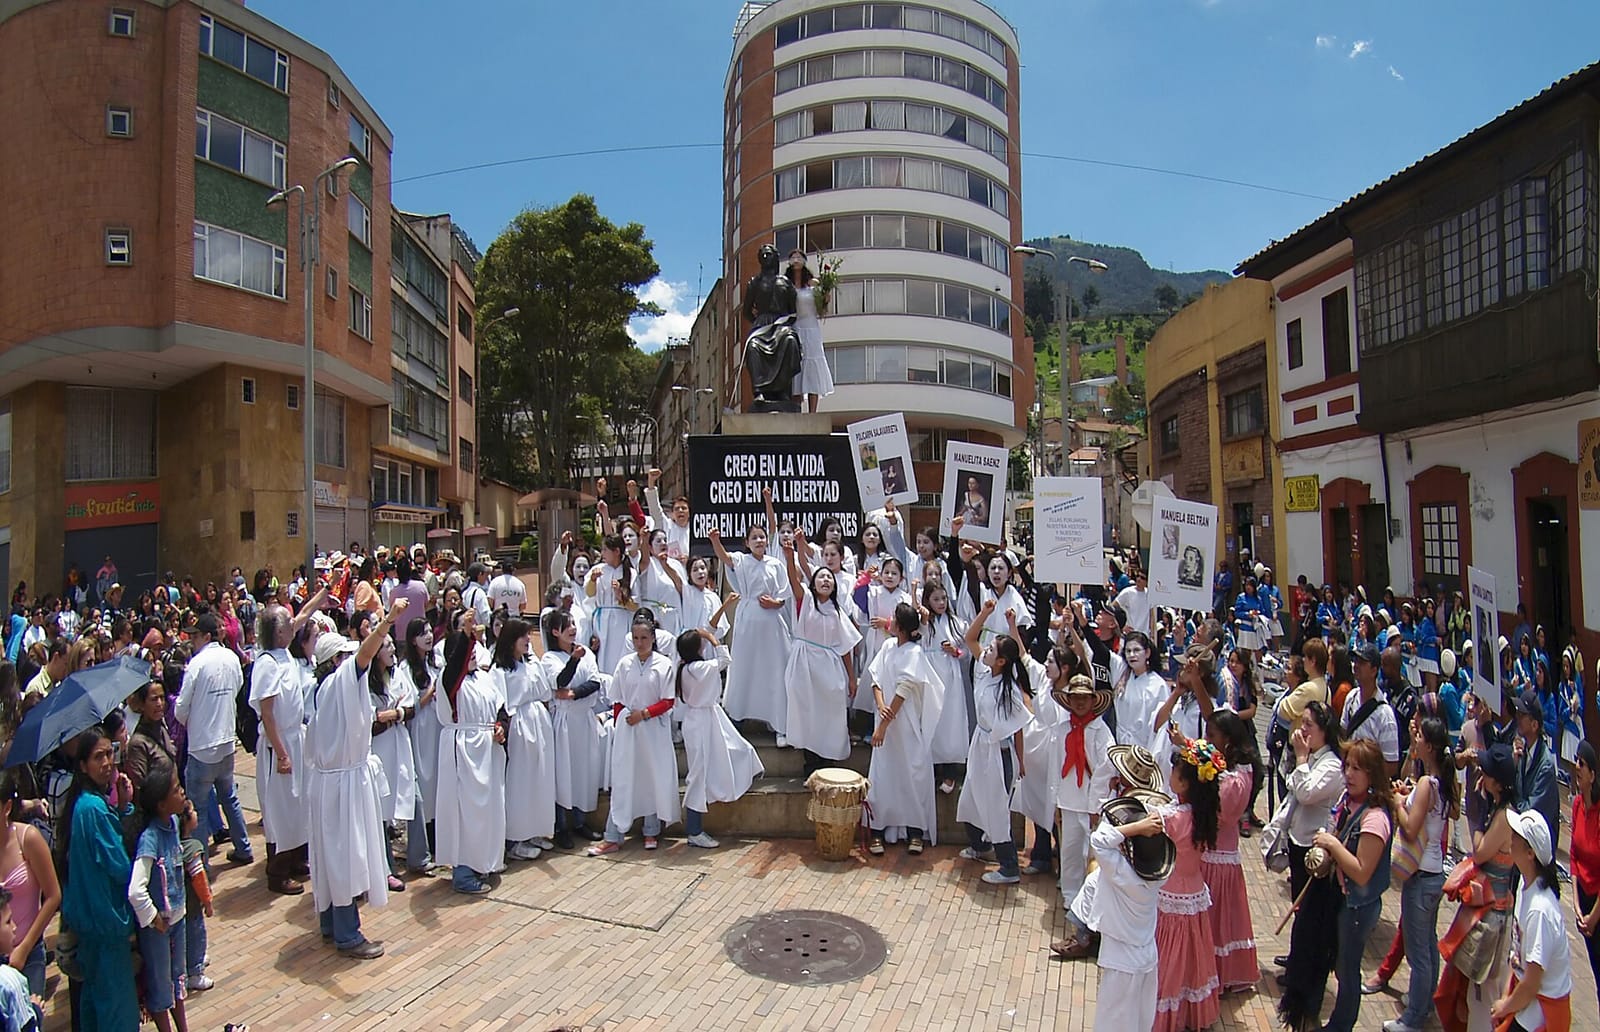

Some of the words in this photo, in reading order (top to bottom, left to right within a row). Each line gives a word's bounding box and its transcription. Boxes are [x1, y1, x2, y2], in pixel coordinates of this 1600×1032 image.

[724, 454, 757, 477] CREO
[759, 454, 776, 476] EN
[779, 454, 795, 476] LA
[796, 454, 825, 477] VIDA
[953, 452, 982, 466] MANUELITA
[709, 480, 742, 504] CREO
[745, 480, 761, 503] EN
[783, 480, 840, 503] LIBERTAD
[720, 512, 733, 538] EN
[734, 512, 747, 537] LA
[815, 511, 858, 537] MRES
[1161, 509, 1186, 524] MANUELA
